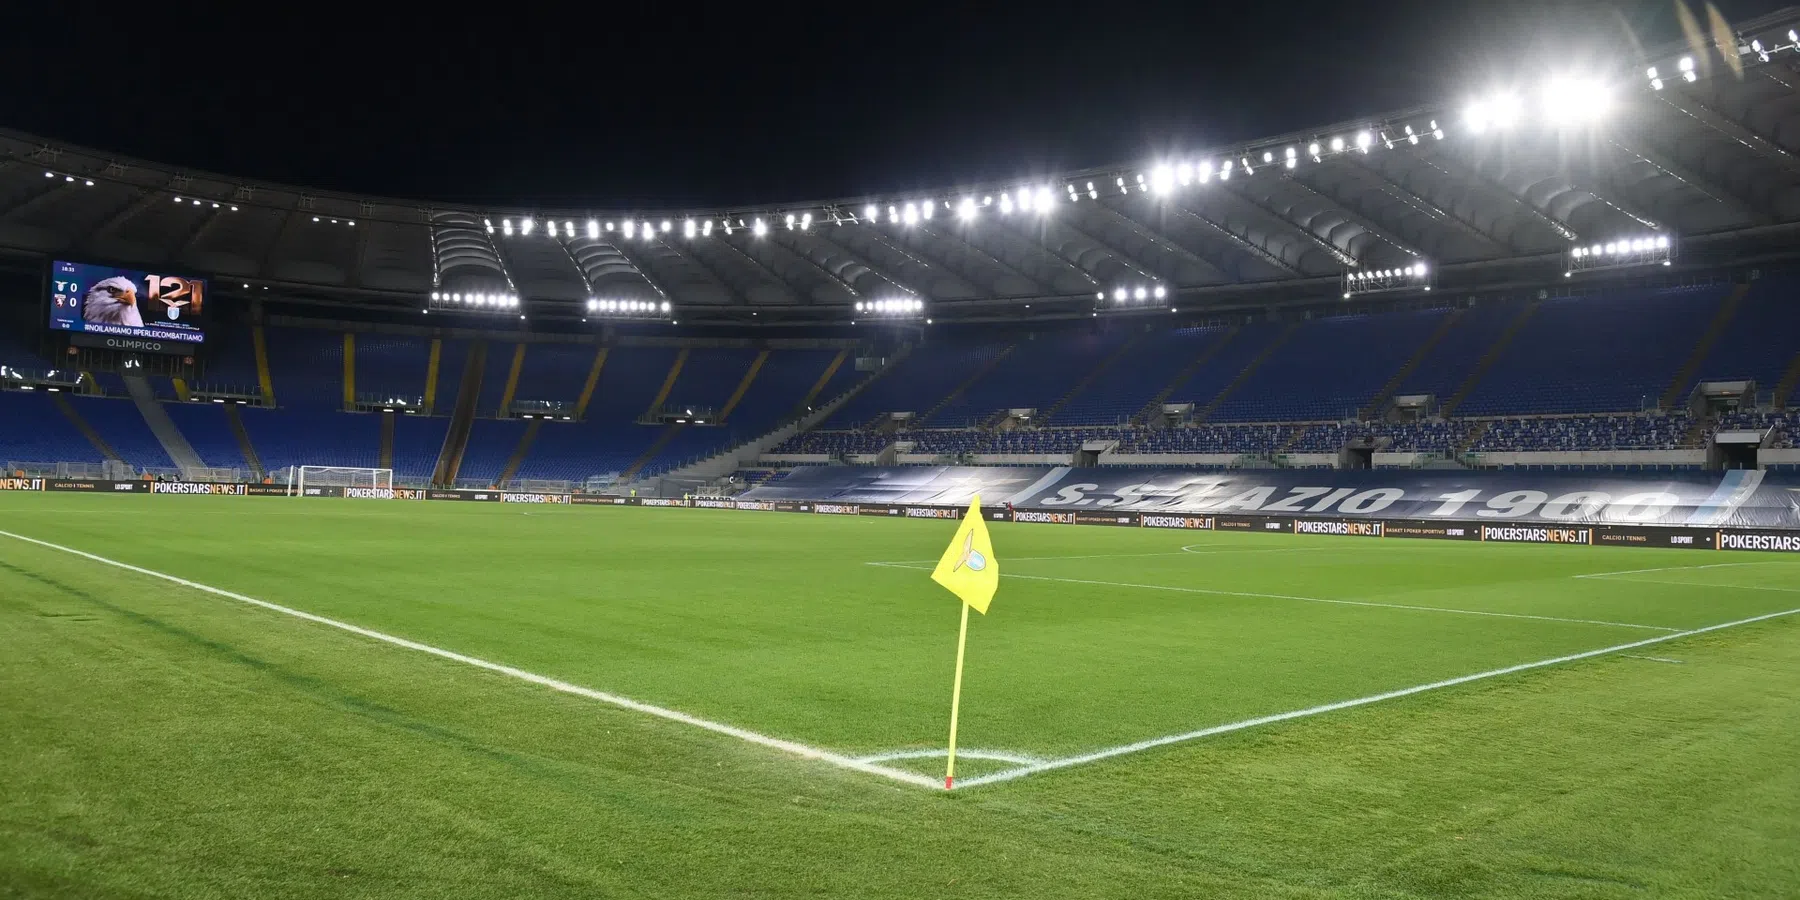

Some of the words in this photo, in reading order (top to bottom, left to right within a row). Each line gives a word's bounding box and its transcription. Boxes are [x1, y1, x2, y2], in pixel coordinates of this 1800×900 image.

[70, 283, 78, 292] 0
[144, 274, 203, 313] 121
[70, 298, 76, 308] 0
[84, 324, 132, 335] #NOILAMIAMO
[133, 328, 203, 342] #PERLEICOMBATTIAMO
[106, 338, 162, 350] OLIMPICO
[154, 482, 244, 495] POKERSTARSNEWS.IT
[503, 493, 569, 504] POKERSTARSNEWS.IT
[1429, 489, 1680, 521] 1900
[1016, 512, 1073, 524] POKERSTARSNEWS.IT
[1144, 516, 1212, 529] POKERSTARSNEWS.IT
[1298, 521, 1381, 535] POKERSTARSNEWS.IT
[1484, 528, 1588, 543] POKERSTARSNEWS.IT
[1721, 534, 1800, 551] POKERSTARS
